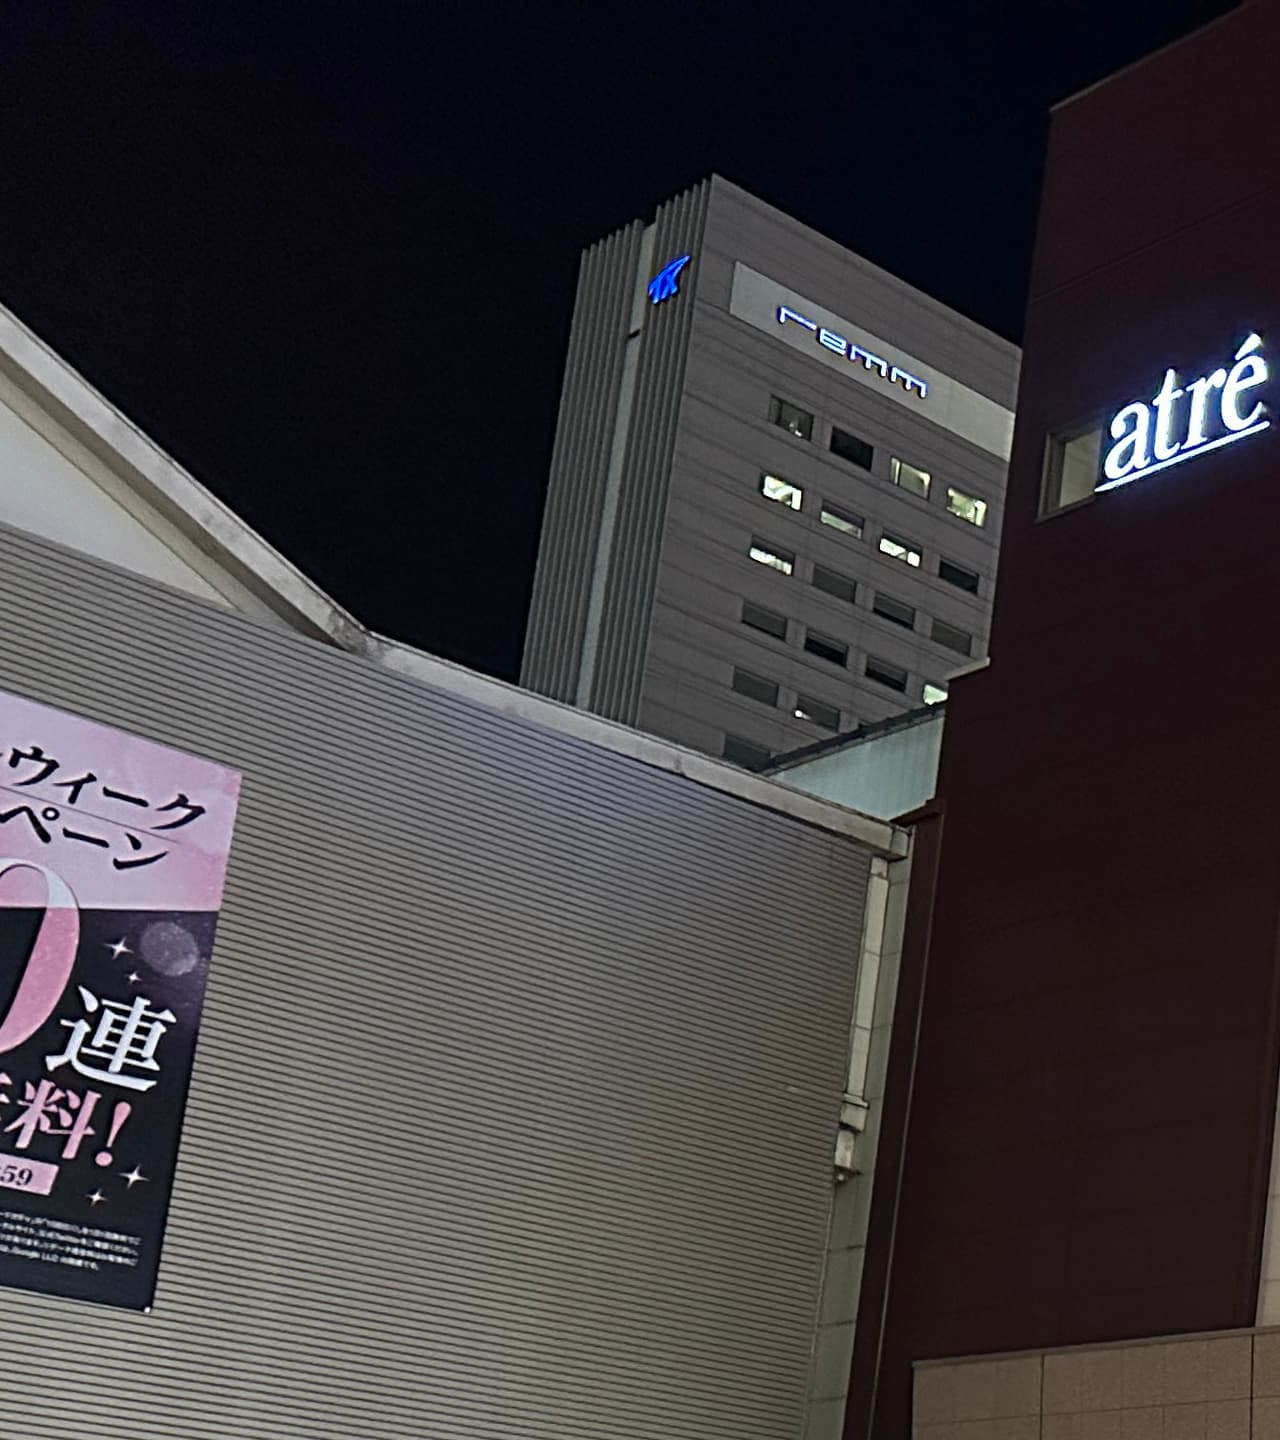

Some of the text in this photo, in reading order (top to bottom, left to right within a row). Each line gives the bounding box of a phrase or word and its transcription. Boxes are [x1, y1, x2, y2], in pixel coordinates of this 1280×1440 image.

[776, 305, 928, 398] remm
[1102, 332, 1269, 480] atré
[0, 746, 206, 830] ウィーク
[0, 1072, 132, 1167] 料!
